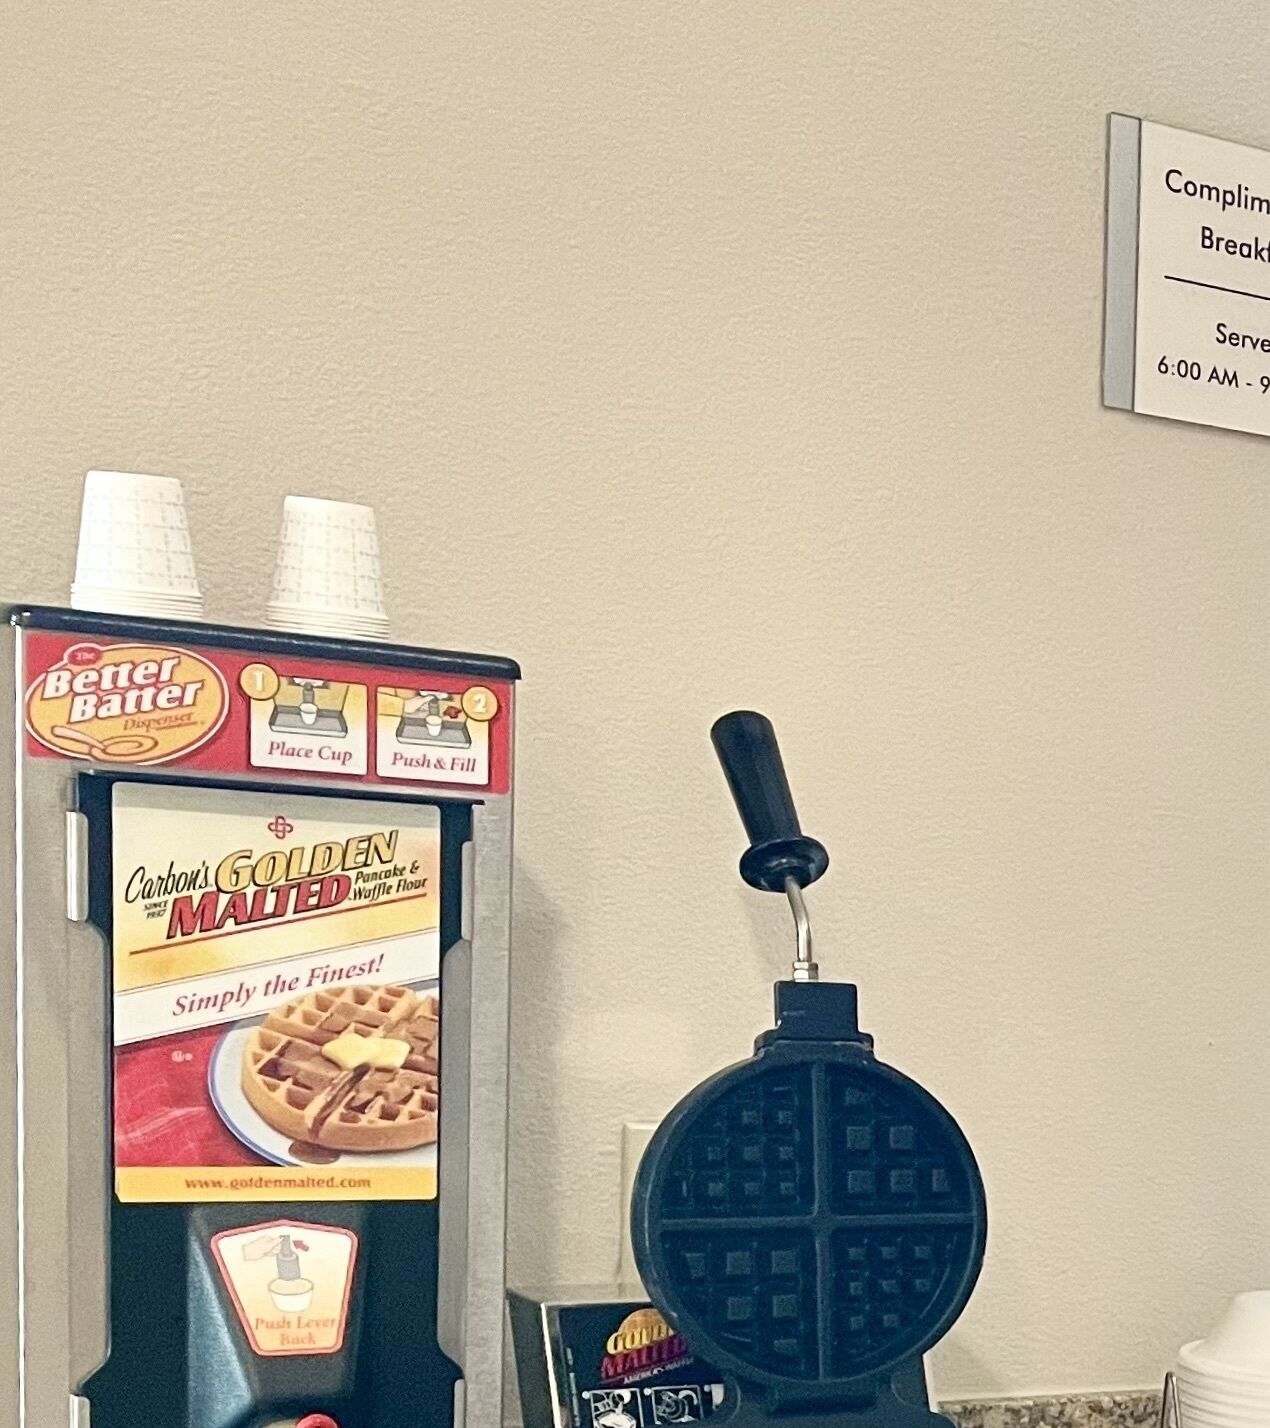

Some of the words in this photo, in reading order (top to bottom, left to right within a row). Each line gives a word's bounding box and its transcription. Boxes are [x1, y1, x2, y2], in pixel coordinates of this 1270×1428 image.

[1157, 355, 1201, 381] 6:00
[1207, 365, 1239, 388] AM
[40, 656, 181, 701] Better
[67, 679, 206, 724] Batter
[123, 711, 193, 733] Dispenser
[268, 741, 314, 760] Place
[318, 746, 353, 766] Cup
[391, 752, 432, 769] Push
[433, 759, 446, 770] &
[449, 758, 477, 773] Fill
[214, 829, 399, 894] GOLDEN
[354, 863, 406, 886] Pancake
[409, 860, 420, 875] &
[125, 859, 209, 904] Carbon's
[353, 881, 393, 902] Waffle
[396, 877, 428, 894] Flour
[165, 873, 351, 940] MALTED
[172, 982, 256, 1017] Simply
[263, 971, 298, 997] the
[304, 952, 385, 988] Finest!
[184, 1175, 372, 1192] www.goldenmalted.com
[255, 1316, 291, 1330] Push
[297, 1316, 337, 1329] Lever
[279, 1332, 317, 1346] Back
[606, 1323, 675, 1355] GOLD
